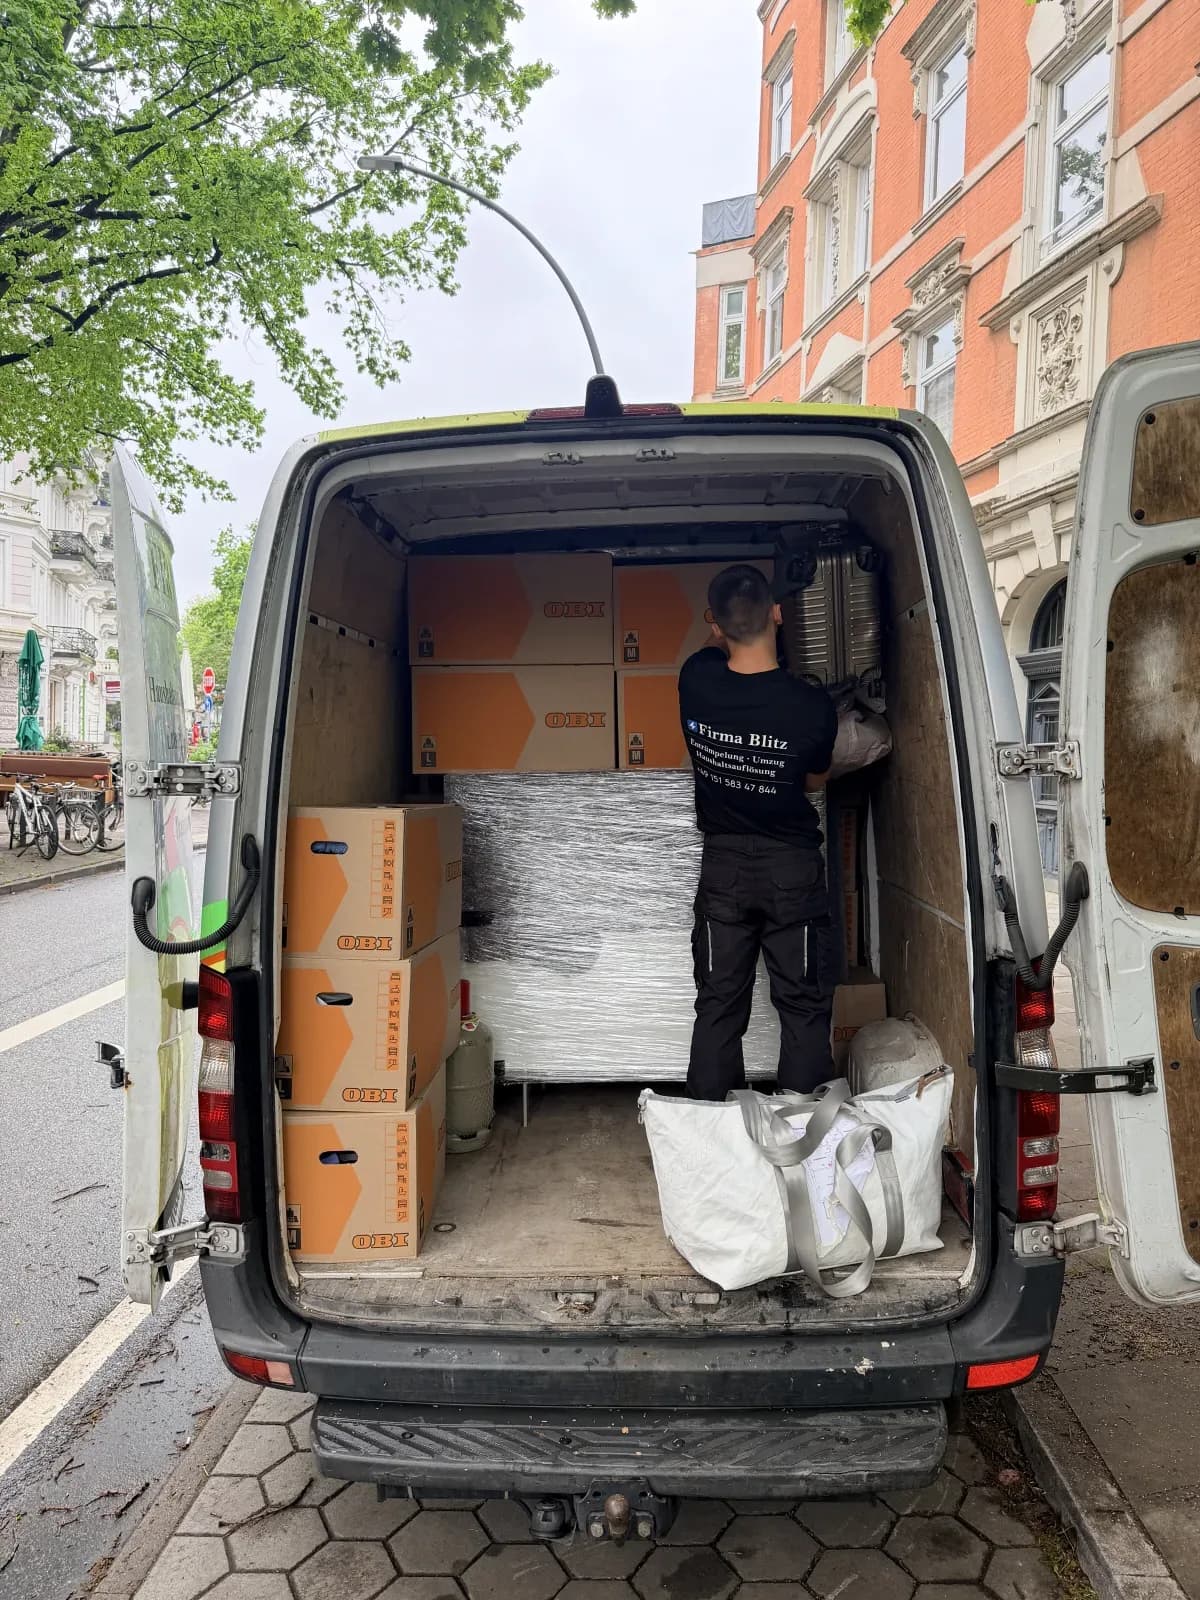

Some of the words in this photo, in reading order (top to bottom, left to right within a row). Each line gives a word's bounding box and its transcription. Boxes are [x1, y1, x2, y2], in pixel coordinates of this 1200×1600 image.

[544, 601, 605, 617] OBI
[544, 712, 606, 728] OBI
[698, 722, 743, 744] Firma
[749, 733, 789, 750] Blitz
[690, 738, 745, 763] Entrümpelung
[752, 755, 785, 768] Umzug
[696, 750, 776, 777] Haushaltsauflösung
[710, 774, 723, 784] 151
[724, 778, 742, 789] 583
[744, 783, 756, 792] 47
[758, 785, 777, 795] 844
[337, 935, 393, 951] OBI
[342, 1087, 398, 1103] OBI
[352, 1232, 410, 1249] OBI
